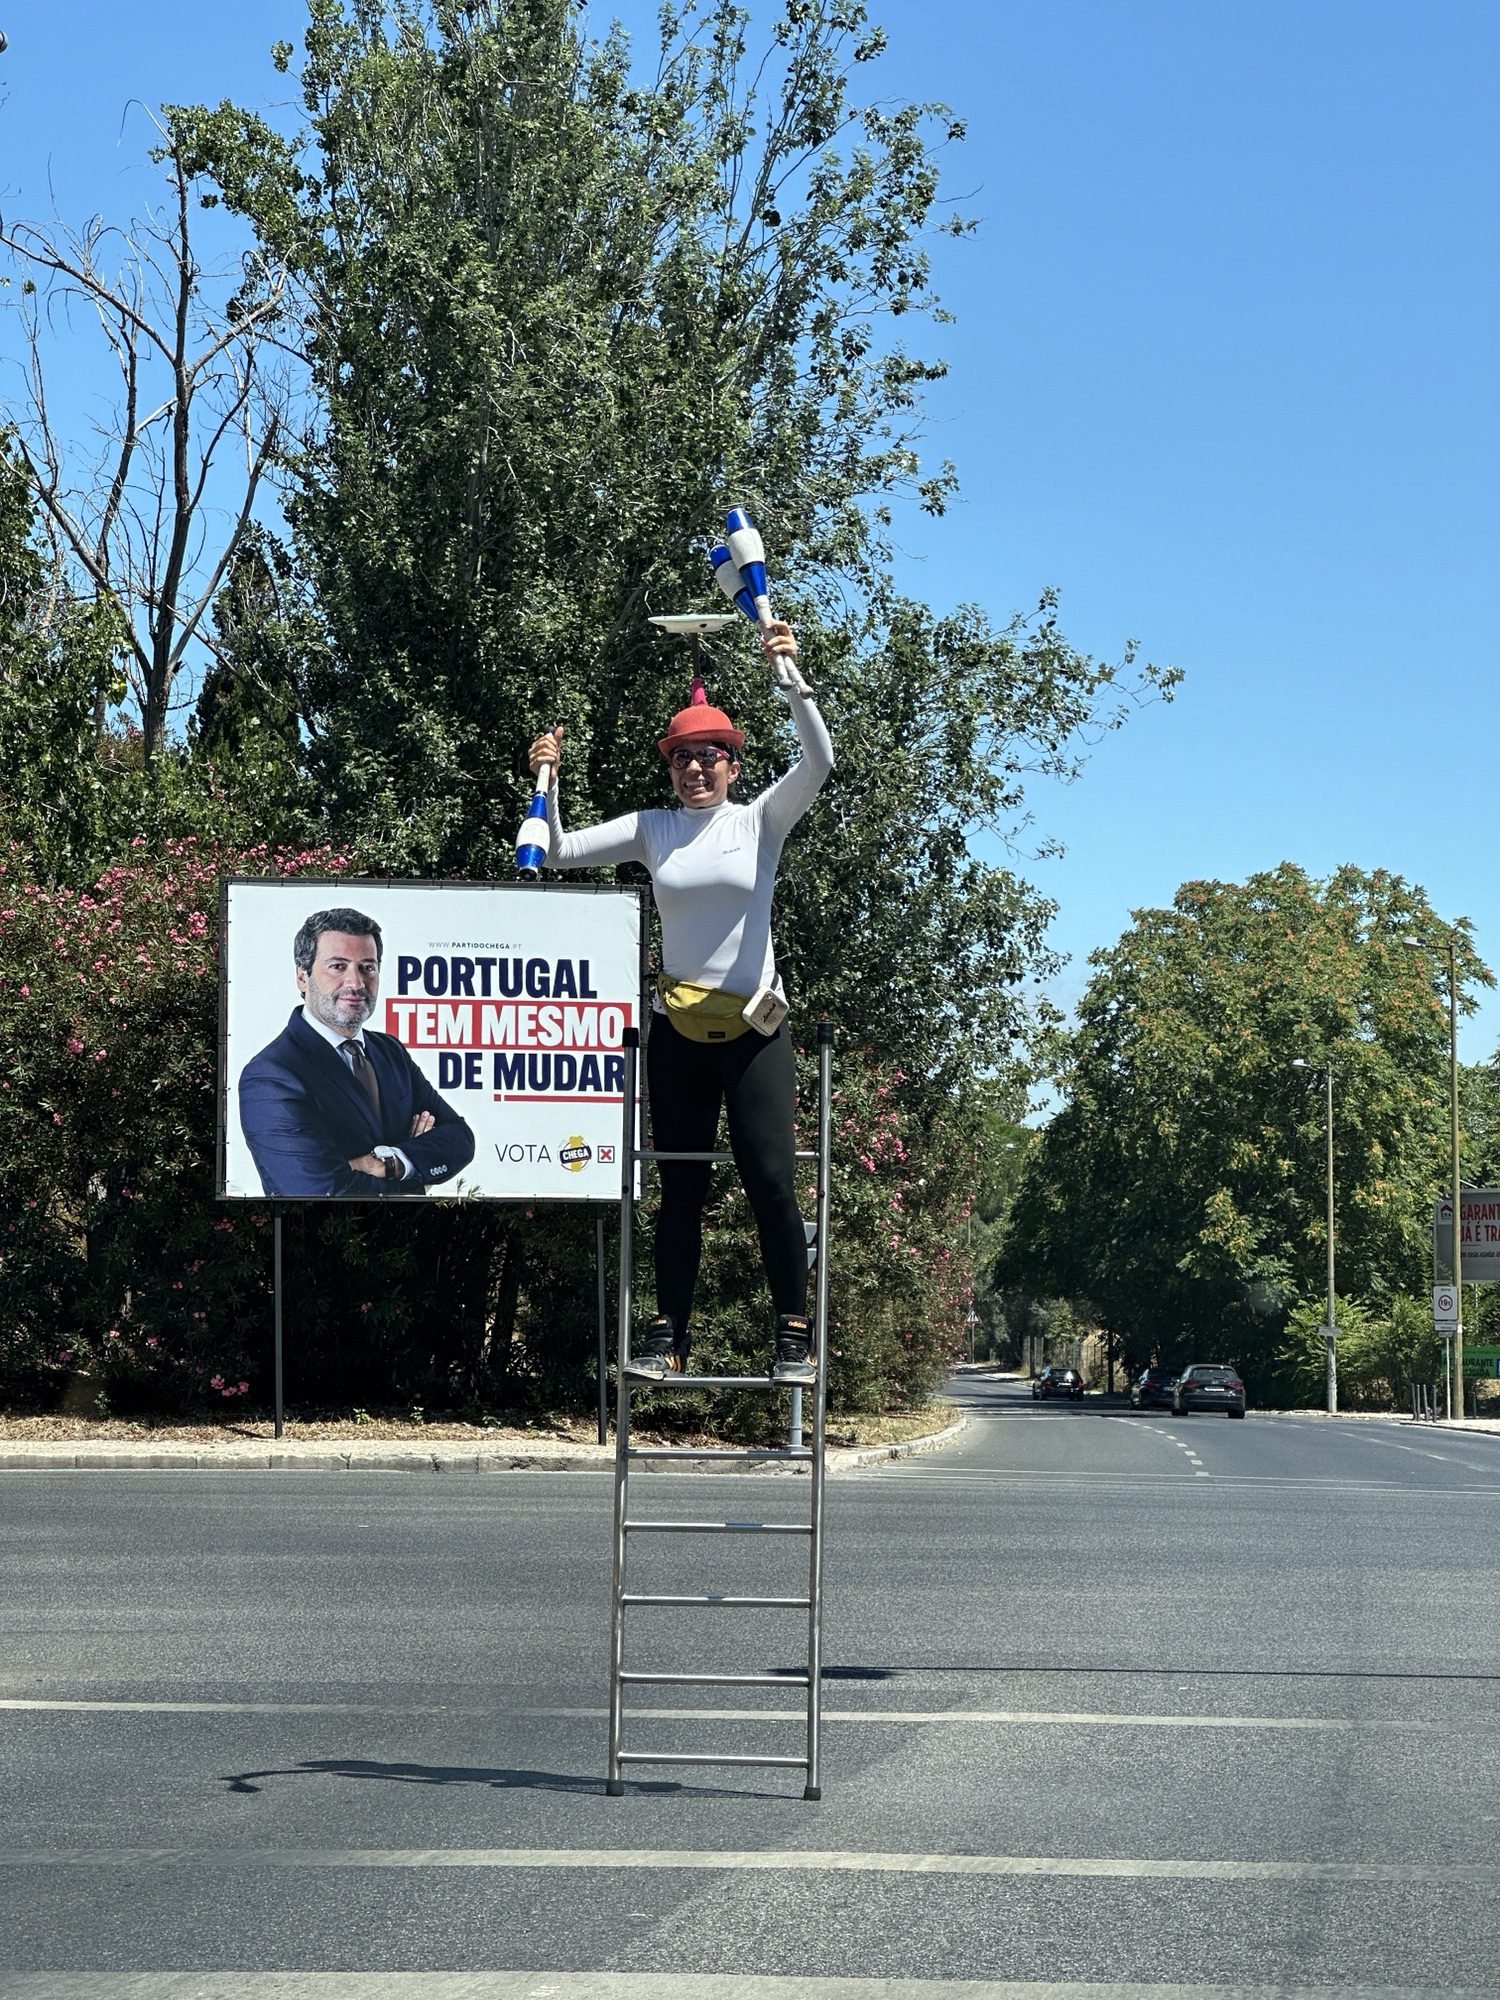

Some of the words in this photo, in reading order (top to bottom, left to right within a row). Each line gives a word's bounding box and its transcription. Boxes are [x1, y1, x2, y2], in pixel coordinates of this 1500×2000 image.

[428, 942, 522, 950] WWW.PARTIDOCHEGA.PT
[398, 955, 597, 999] PORTUGAL
[392, 1003, 473, 1045] TEM
[481, 1004, 625, 1048] MESMO
[439, 1052, 483, 1090] DE
[494, 1053, 625, 1092] MUDAR
[495, 1144, 552, 1163] VOTA
[562, 1148, 590, 1161] CHEGA
[1475, 1221, 1481, 1242] É
